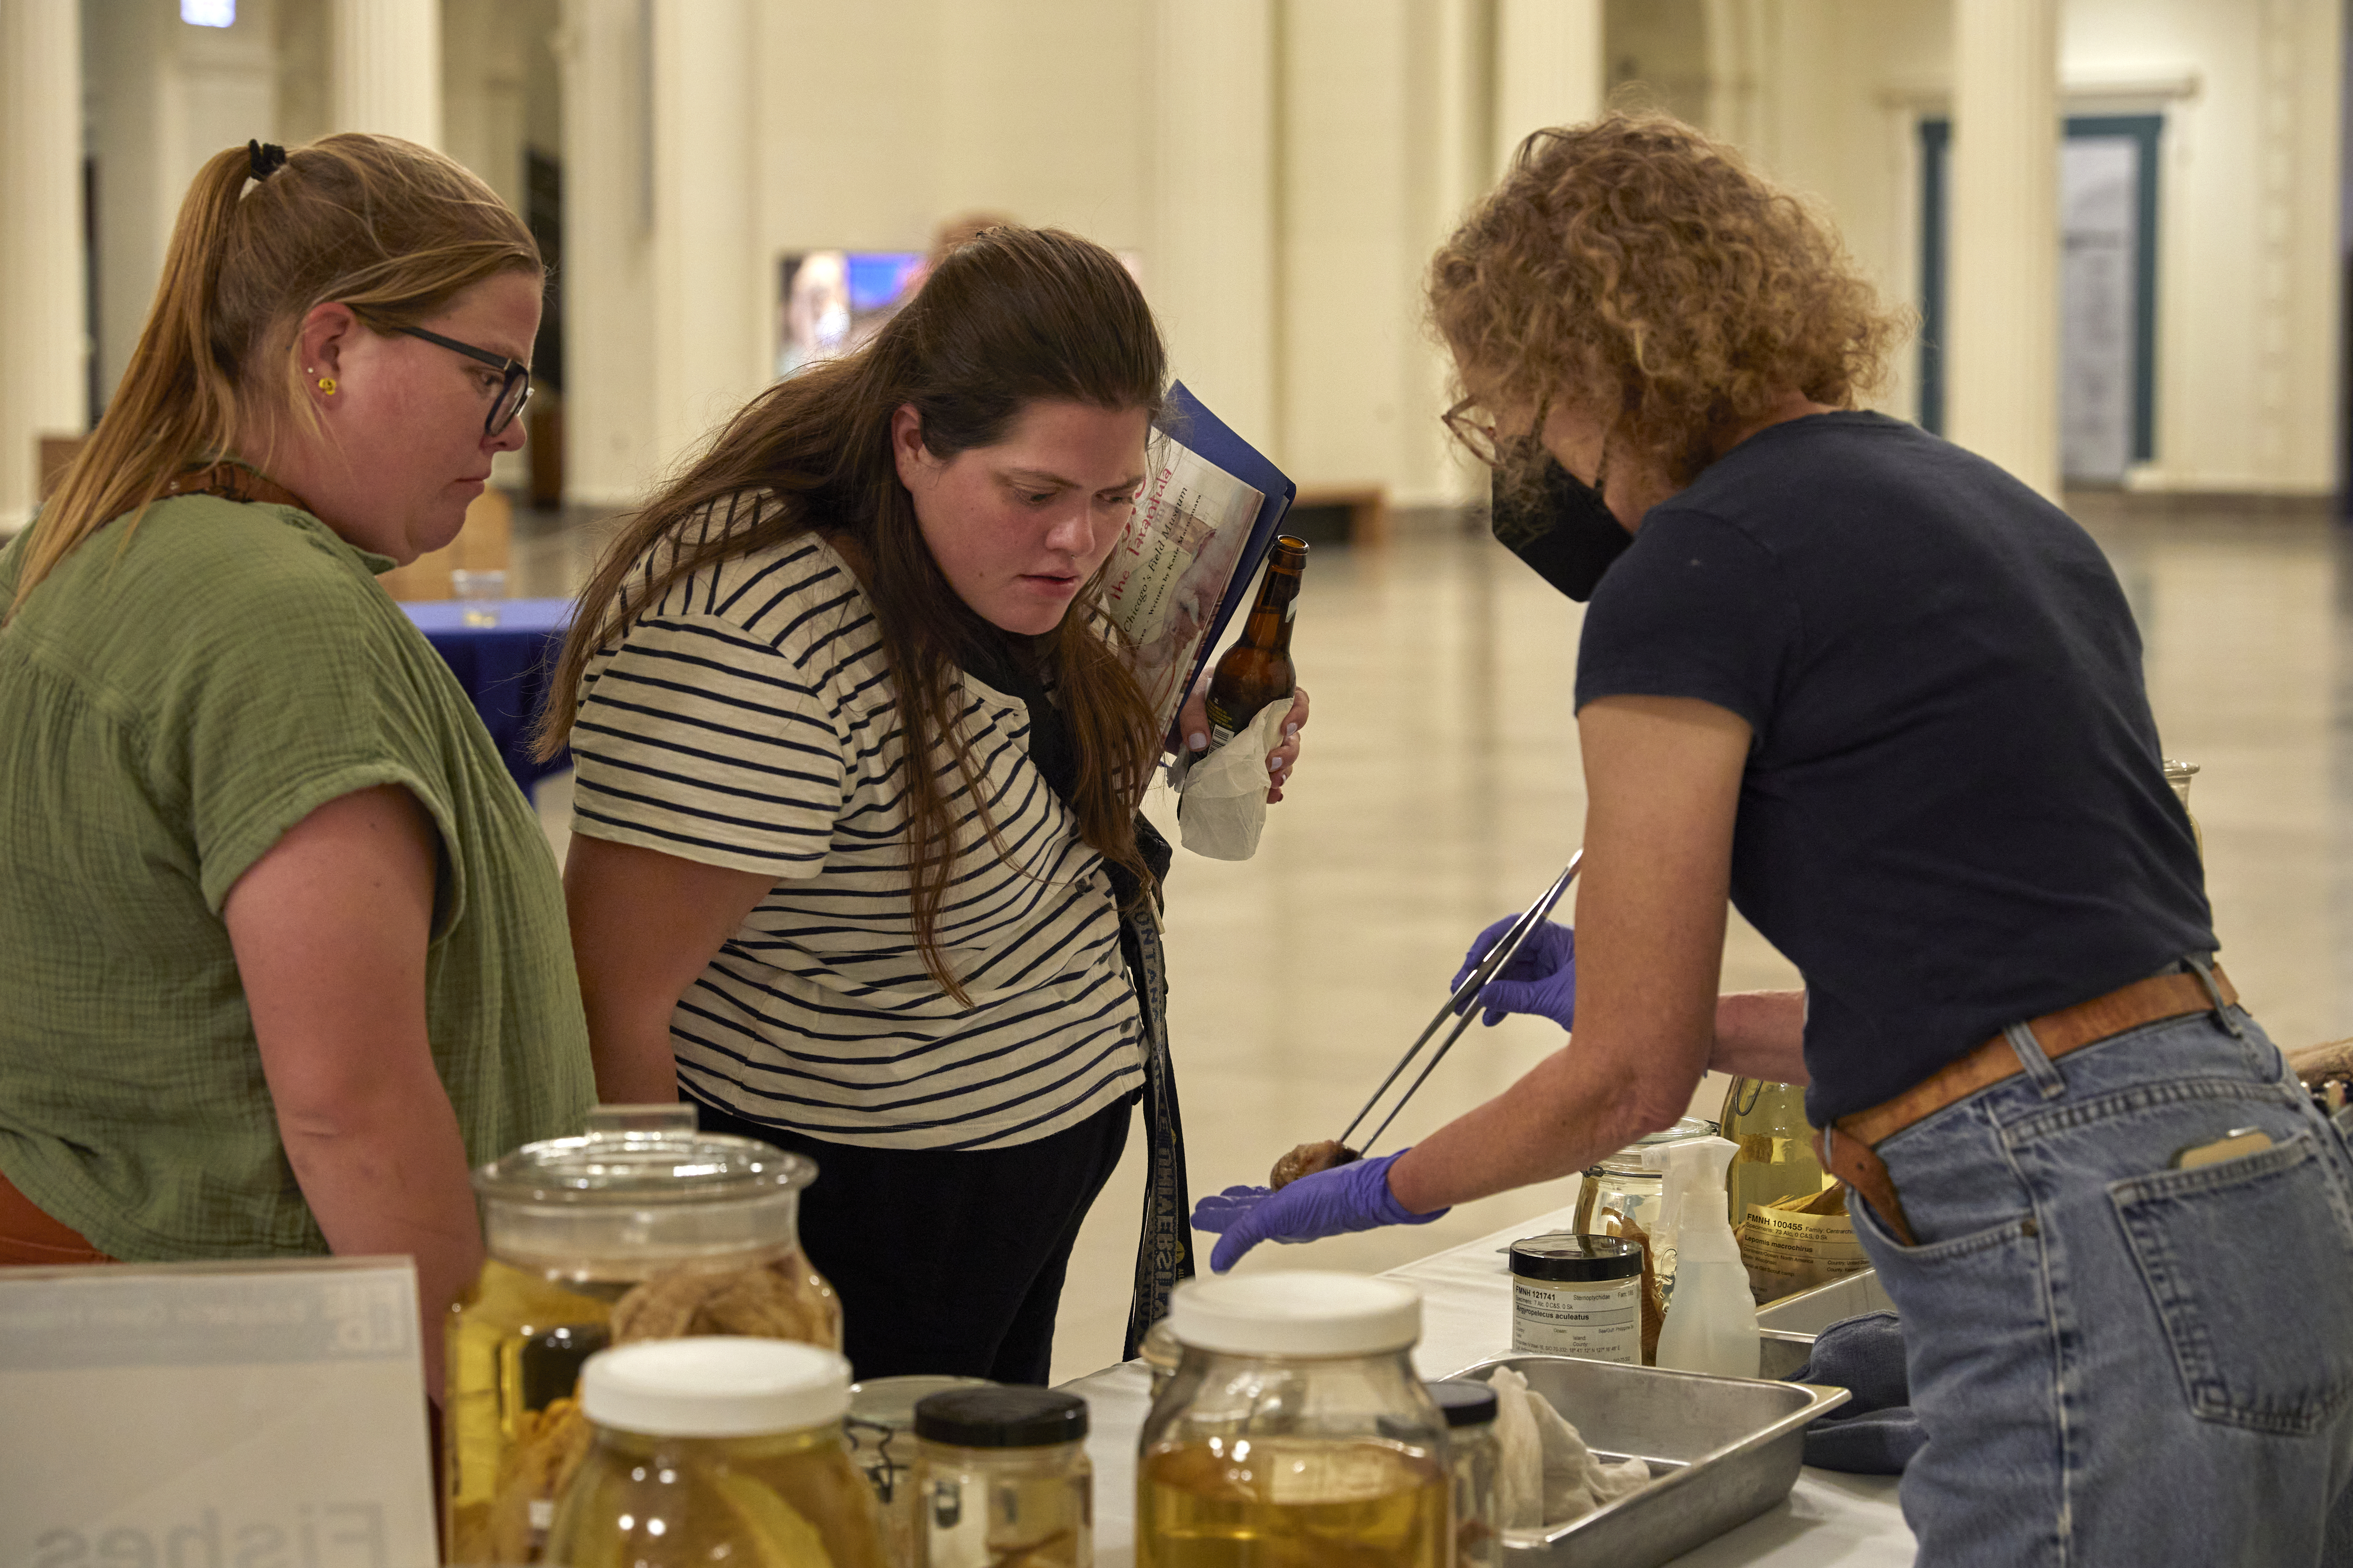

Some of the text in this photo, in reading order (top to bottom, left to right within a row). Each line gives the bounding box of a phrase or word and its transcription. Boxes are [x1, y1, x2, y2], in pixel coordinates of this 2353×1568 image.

[1126, 468, 1172, 556] Tarantula
[1124, 574, 1152, 633] Chicago's
[1148, 540, 1165, 573] Field
[1162, 487, 1188, 540] Museum
[1148, 494, 1201, 614] Written by Katie Macnamara
[1135, 902, 1158, 1023] ONTANA
[1746, 1222, 1773, 1233] Specimens:
[1747, 1213, 1770, 1225] FMNH
[1773, 1220, 1802, 1231] 100455
[1745, 1235, 1813, 1252] Lepomis macrochirus
[1755, 1256, 1777, 1265] Wisconsin
[1516, 1286, 1555, 1301] FMNH 121741
[1516, 1304, 1554, 1318] Argyropelecus
